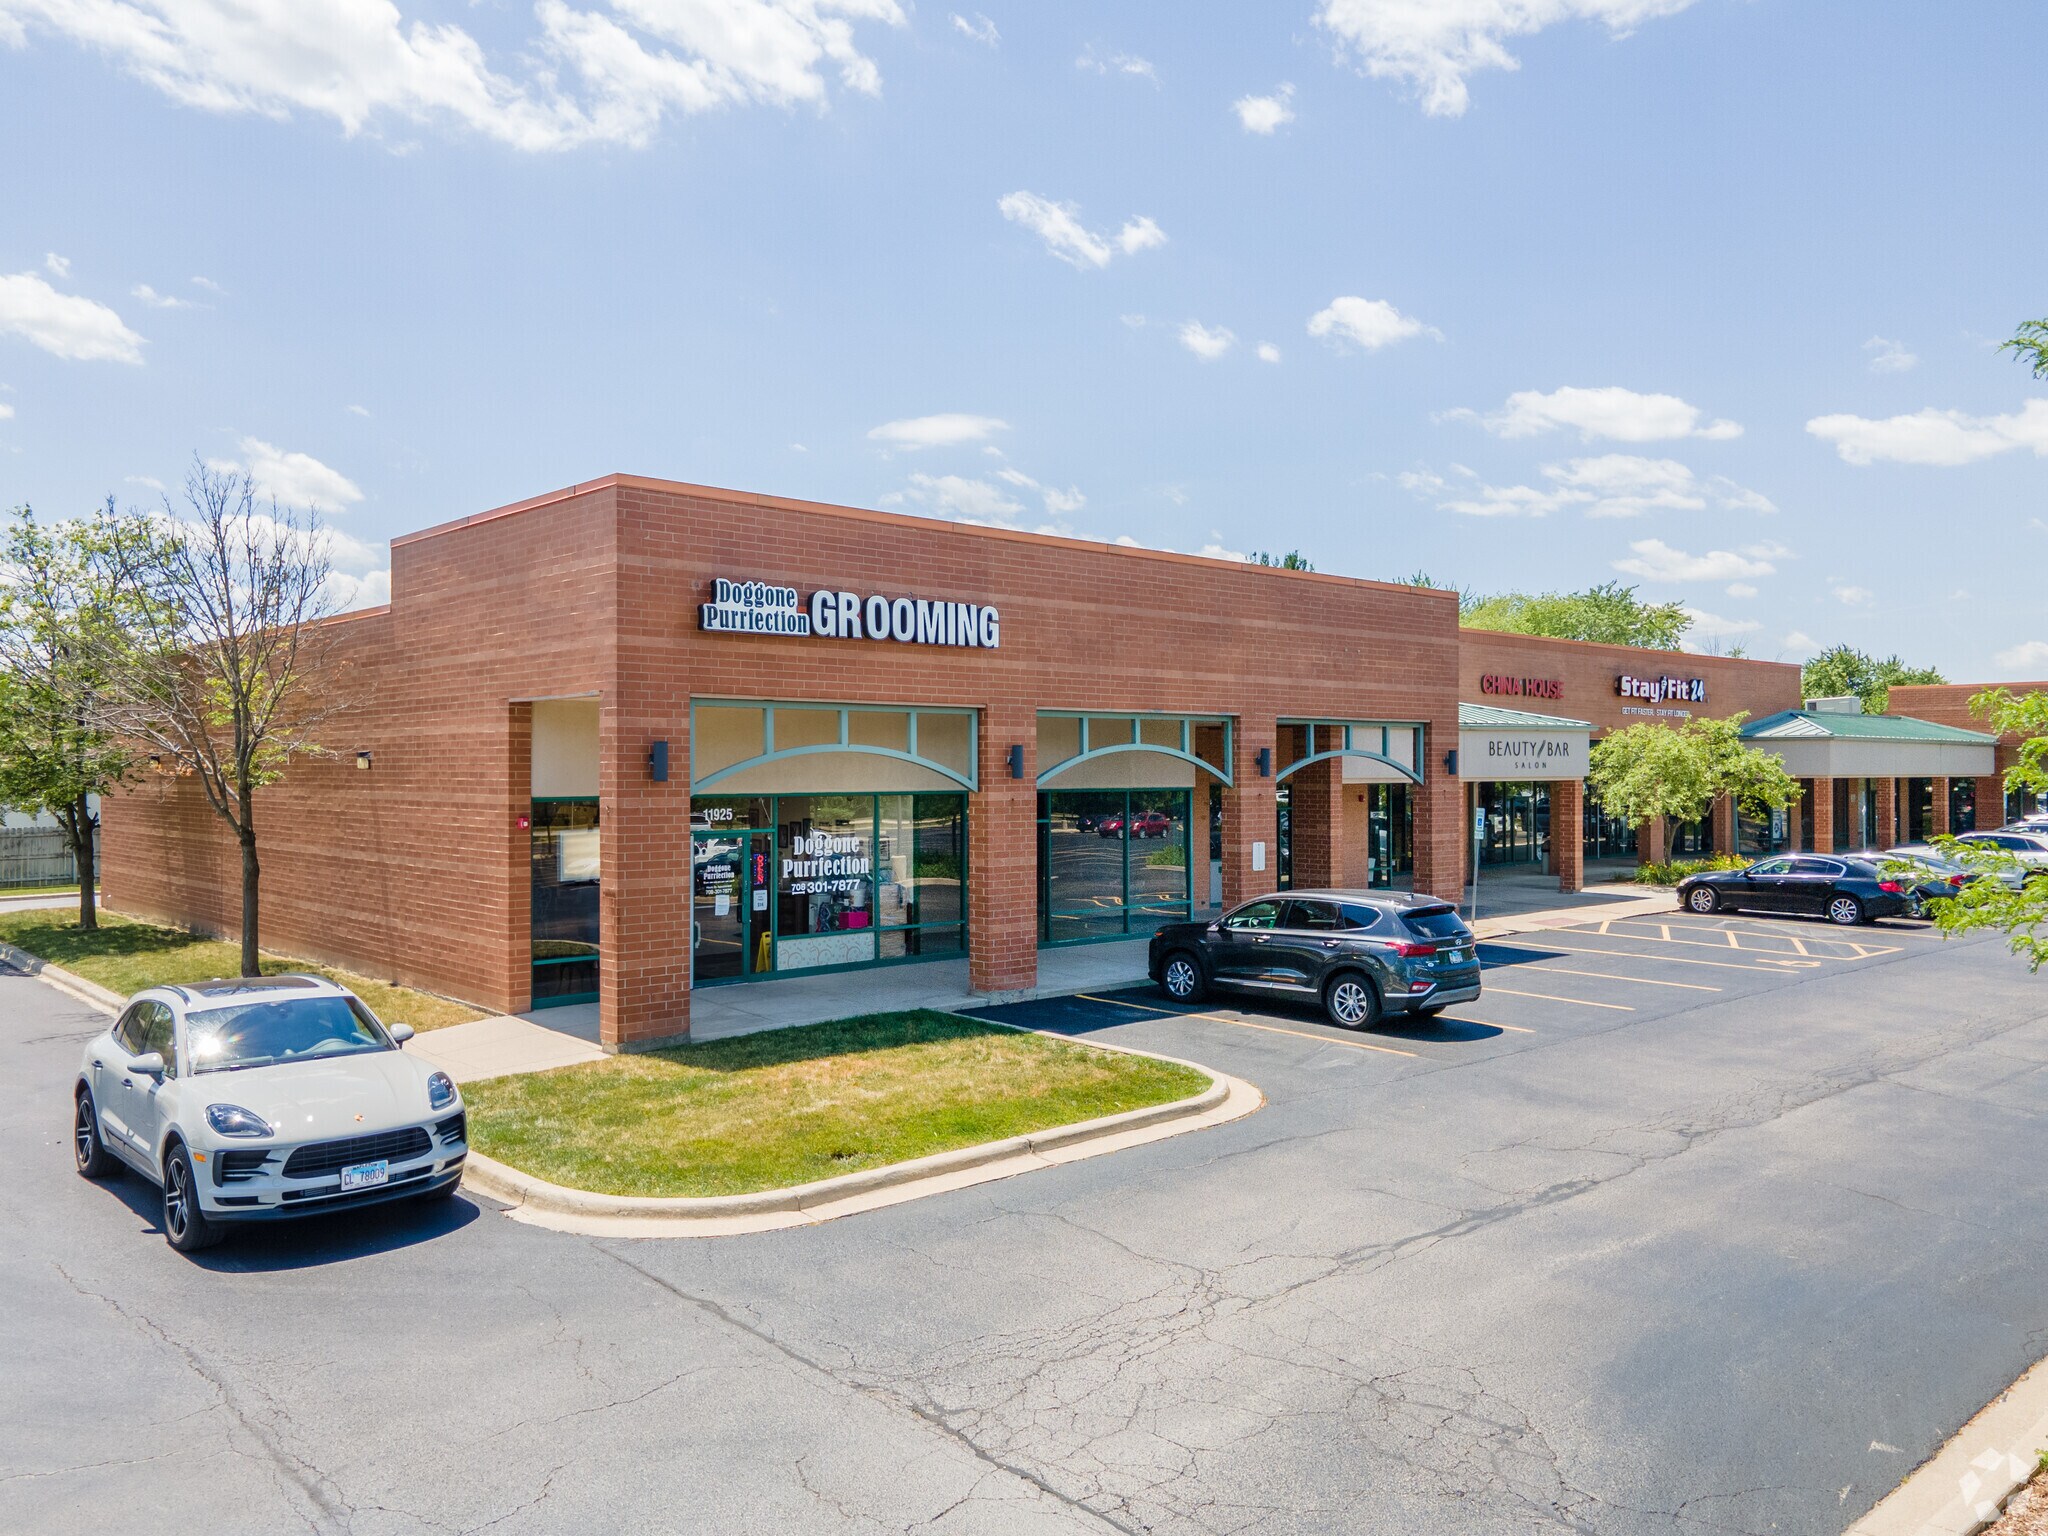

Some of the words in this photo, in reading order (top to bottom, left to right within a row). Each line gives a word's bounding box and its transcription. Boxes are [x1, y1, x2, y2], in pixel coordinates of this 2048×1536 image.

[718, 579, 797, 609] Doggone
[706, 605, 808, 634] Purrfection
[811, 589, 1000, 648] GROOMING
[1482, 674, 1521, 696] CHINA
[1526, 678, 1564, 699] HOUSE
[1620, 675, 1660, 703] Stay
[1667, 678, 1690, 700] Fit
[1514, 761, 1548, 769] SALON
[703, 808, 733, 821] 11925
[793, 835, 860, 857] Doggone
[707, 864, 731, 873] Doggone
[782, 855, 870, 879] Purrfection
[791, 883, 806, 892] 708
[807, 879, 861, 894] 301-7877
